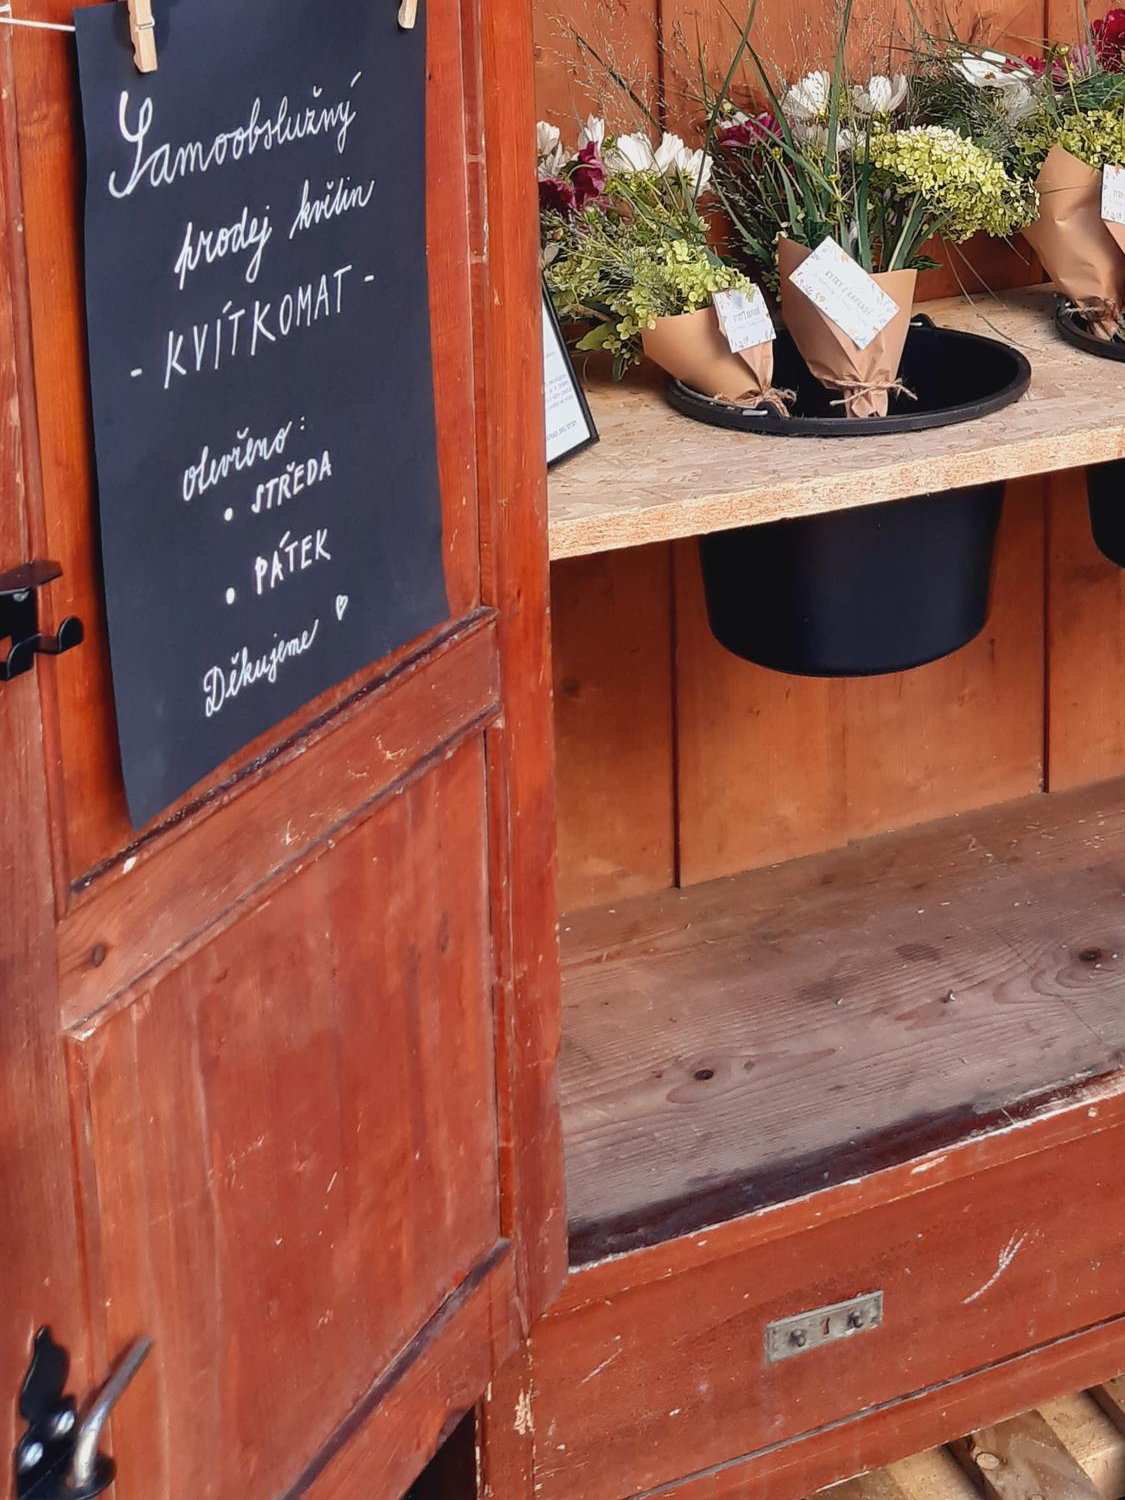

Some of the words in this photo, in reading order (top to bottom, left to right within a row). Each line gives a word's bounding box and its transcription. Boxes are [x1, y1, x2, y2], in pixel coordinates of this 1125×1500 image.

[109, 72, 362, 199] Samoobslužný
[174, 203, 273, 291] prodej
[163, 264, 353, 390] KVÍTKOMAT
[251, 450, 332, 514] STŘEDA
[255, 528, 331, 596] PÁTEK
[204, 618, 318, 718] Děkujeme
